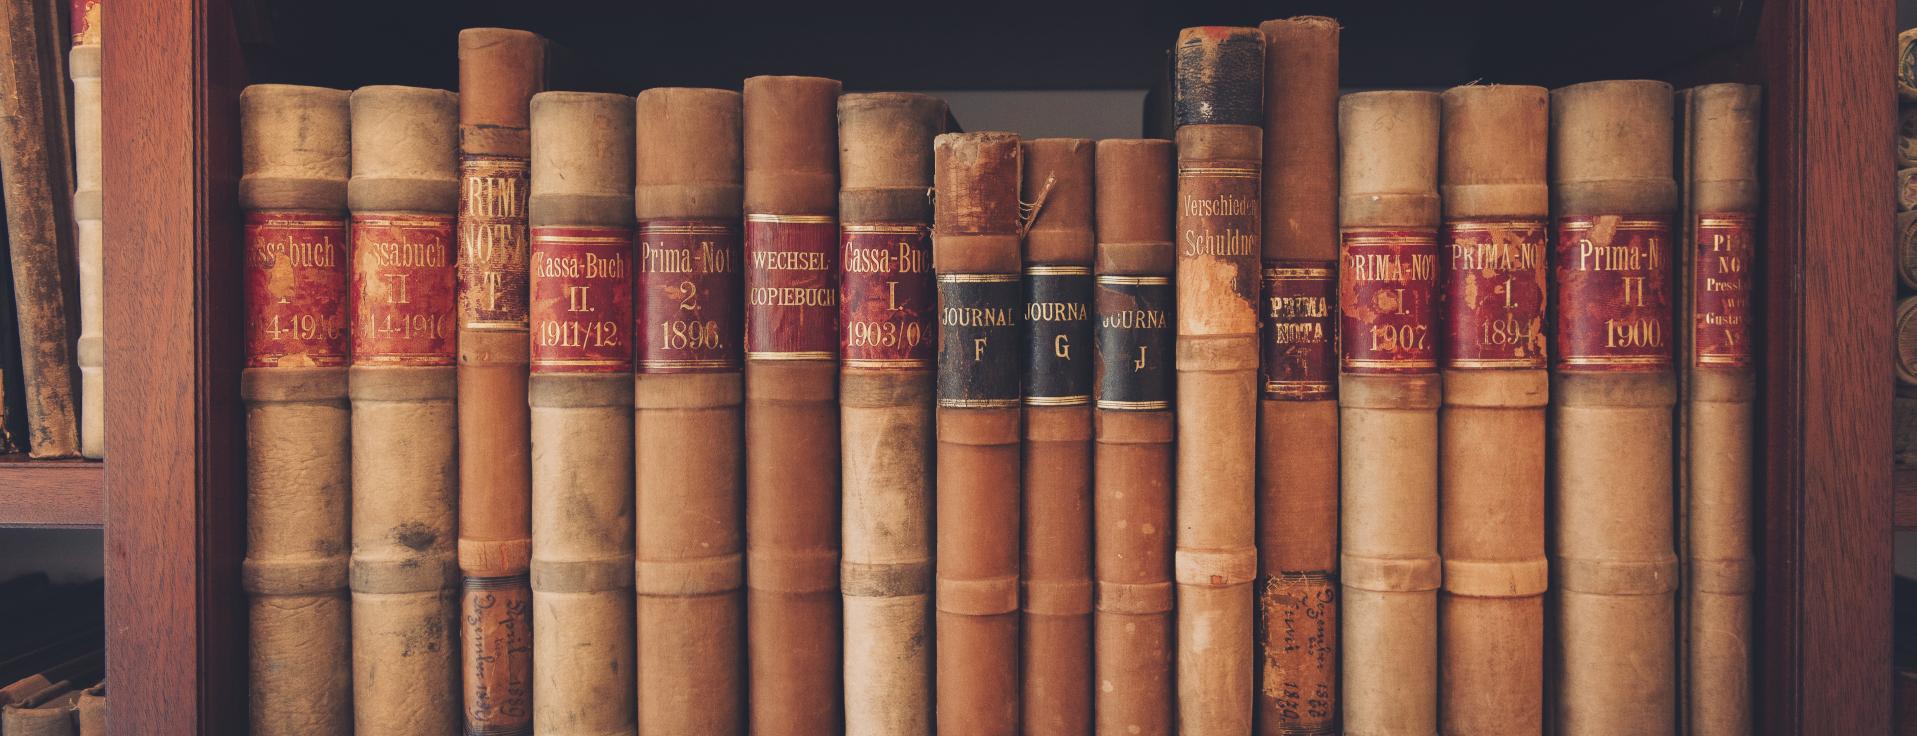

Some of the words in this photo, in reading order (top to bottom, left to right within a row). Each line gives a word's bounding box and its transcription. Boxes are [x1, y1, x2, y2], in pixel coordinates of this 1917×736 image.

[256, 236, 336, 268] ssabuch
[373, 236, 446, 268] ssabuch
[537, 251, 625, 279] Kassa-Buch
[641, 241, 735, 273] Prima-Not
[1580, 238, 1665, 272] Prima-N
[567, 286, 595, 312] II.
[680, 281, 702, 311] 2.
[751, 287, 836, 307] COPIEBUCH
[886, 281, 904, 311] I.
[942, 307, 1016, 327] JOURNAL
[540, 320, 623, 351] 1911/12.
[974, 336, 988, 361] F
[1055, 334, 1071, 361] G
[1134, 345, 1148, 373] J
